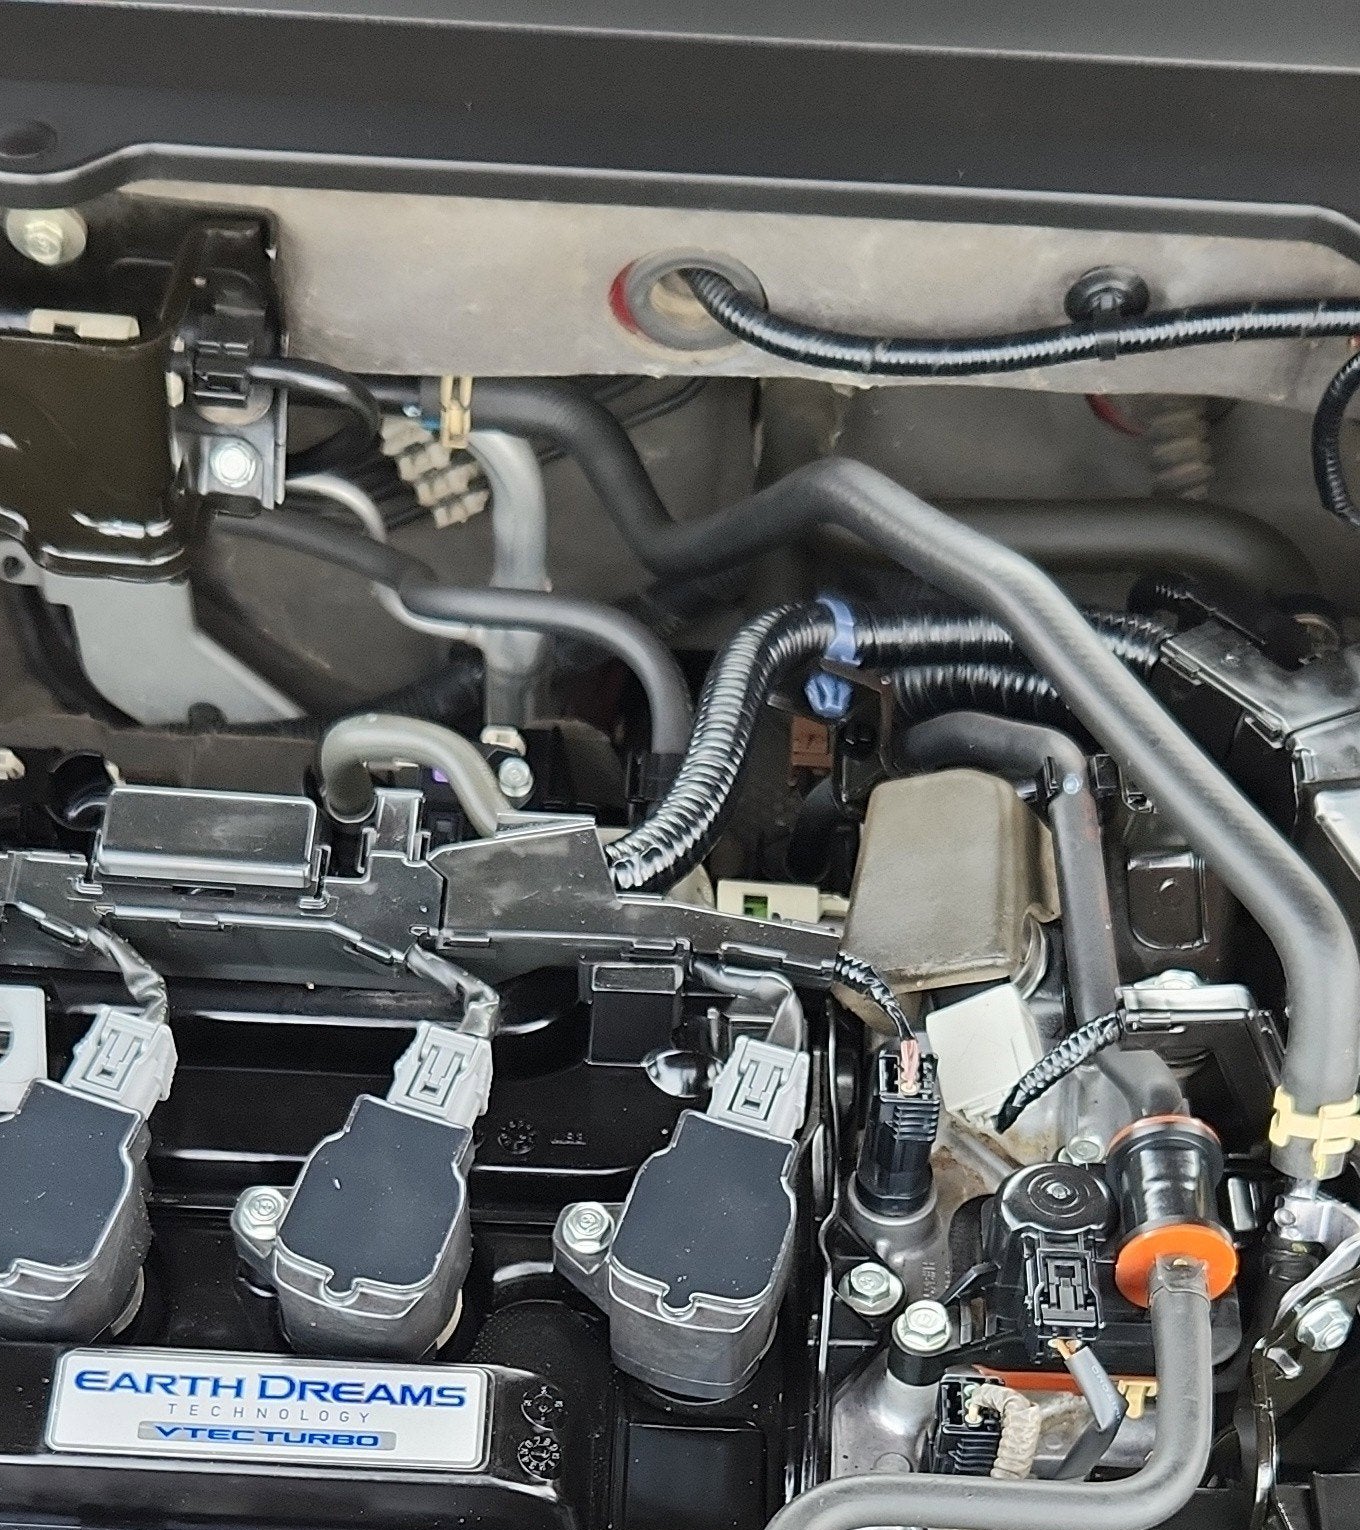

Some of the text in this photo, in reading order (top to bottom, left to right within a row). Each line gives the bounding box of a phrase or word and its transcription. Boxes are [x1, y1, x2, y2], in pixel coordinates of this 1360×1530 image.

[74, 1369, 467, 1408] EARTH DREAMS
[167, 1403, 371, 1424] TECHNOLOGY
